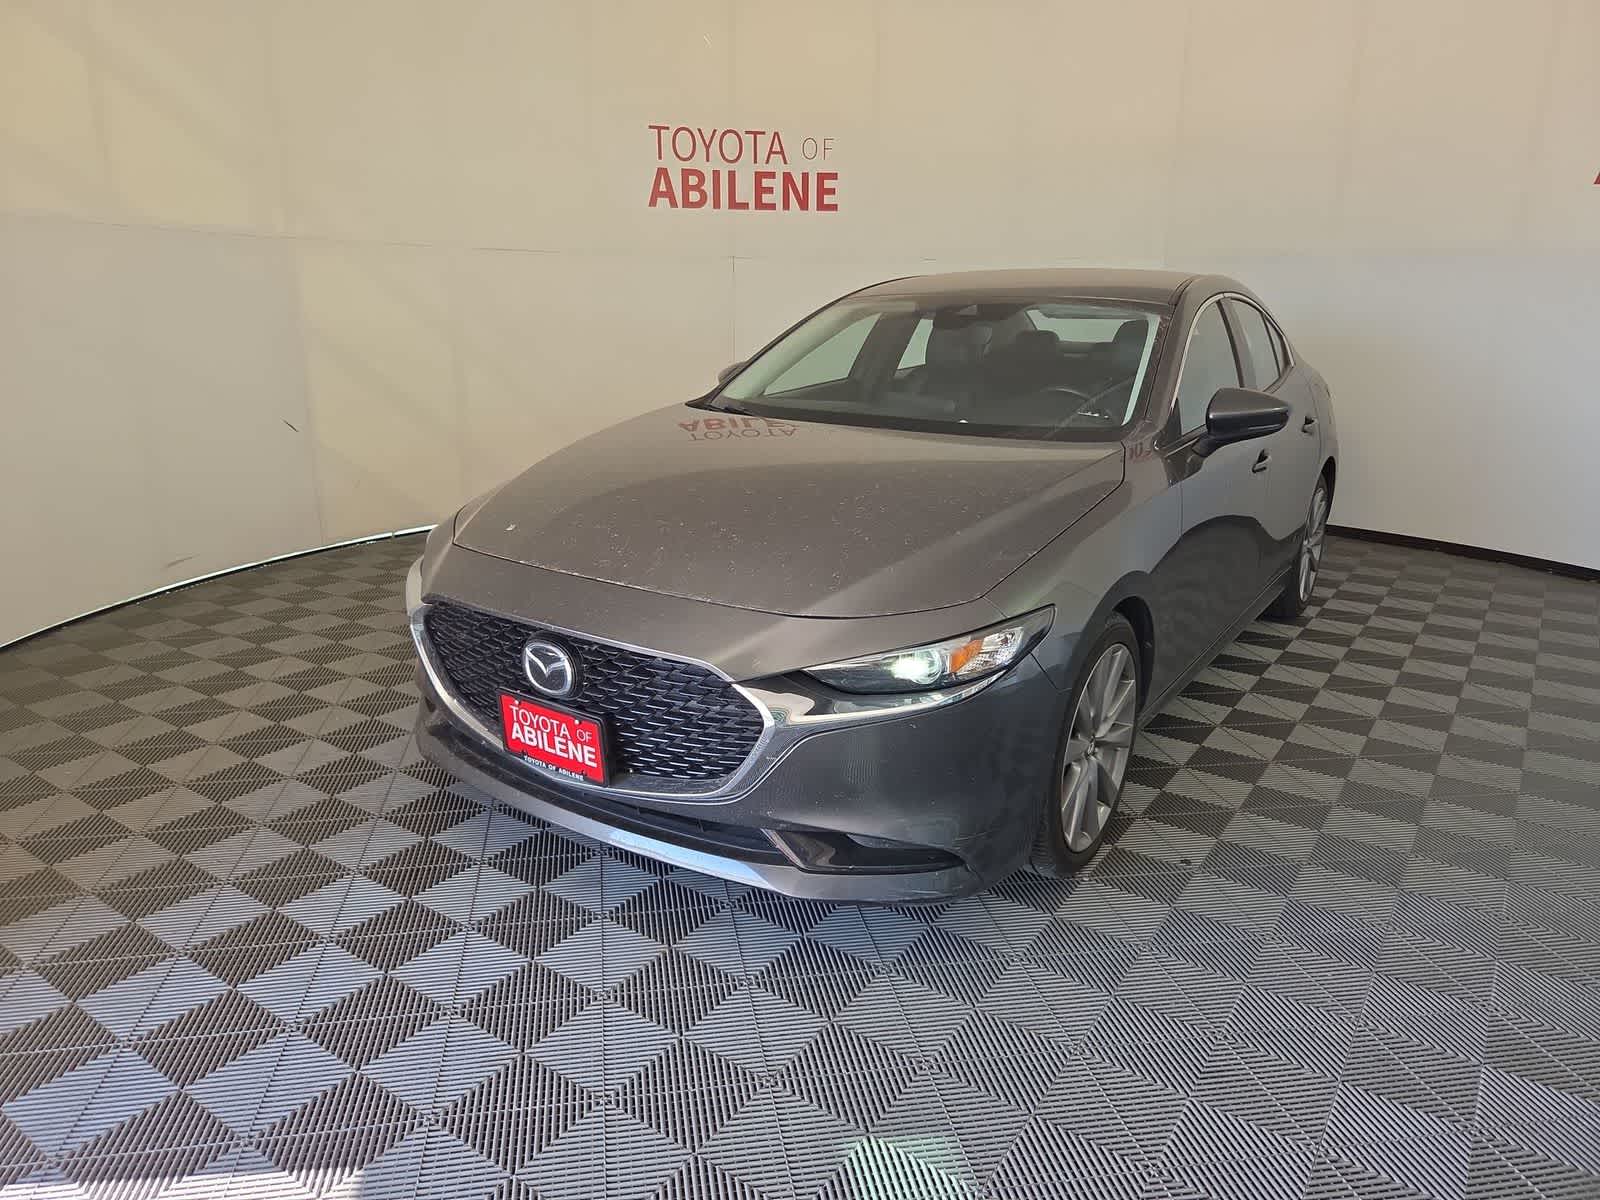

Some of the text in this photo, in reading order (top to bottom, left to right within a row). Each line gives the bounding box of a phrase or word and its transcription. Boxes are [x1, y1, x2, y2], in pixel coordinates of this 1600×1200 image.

[648, 125, 834, 164] TOYOTA OF
[648, 167, 838, 211] ABILENE
[510, 705, 592, 742] TOYOTA OF
[512, 722, 597, 767] ABILENE
[524, 755, 547, 768] TOYOTA
[559, 768, 584, 781] ABILENE
